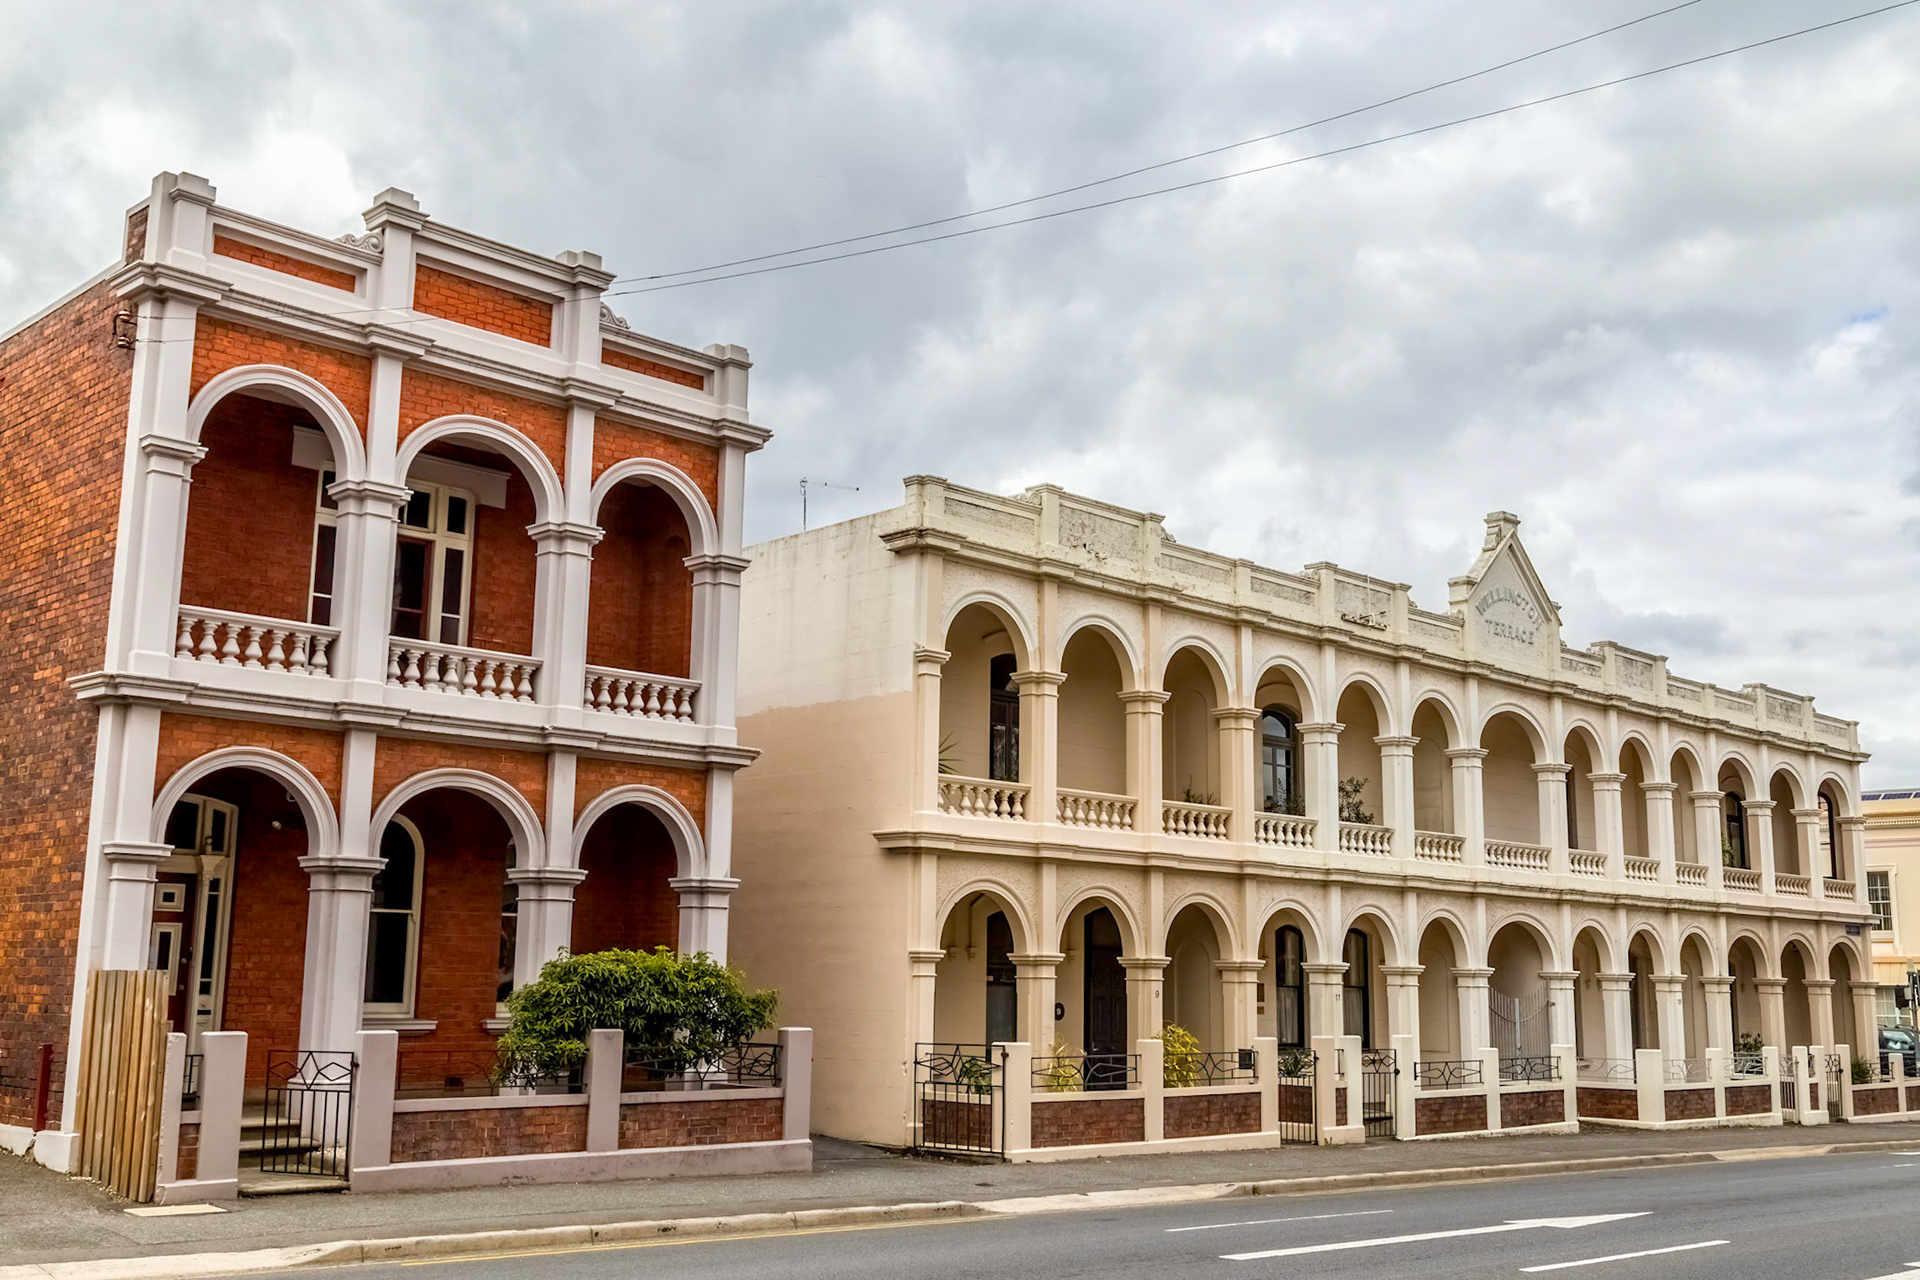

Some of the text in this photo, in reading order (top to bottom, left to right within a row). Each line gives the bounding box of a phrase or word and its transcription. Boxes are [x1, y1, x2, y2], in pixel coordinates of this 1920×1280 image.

[1475, 587, 1541, 631] WELLINGTON
[1485, 618, 1534, 645] TERRACE
[1155, 990, 1160, 998] 9
[1335, 993, 1341, 1001] 11
